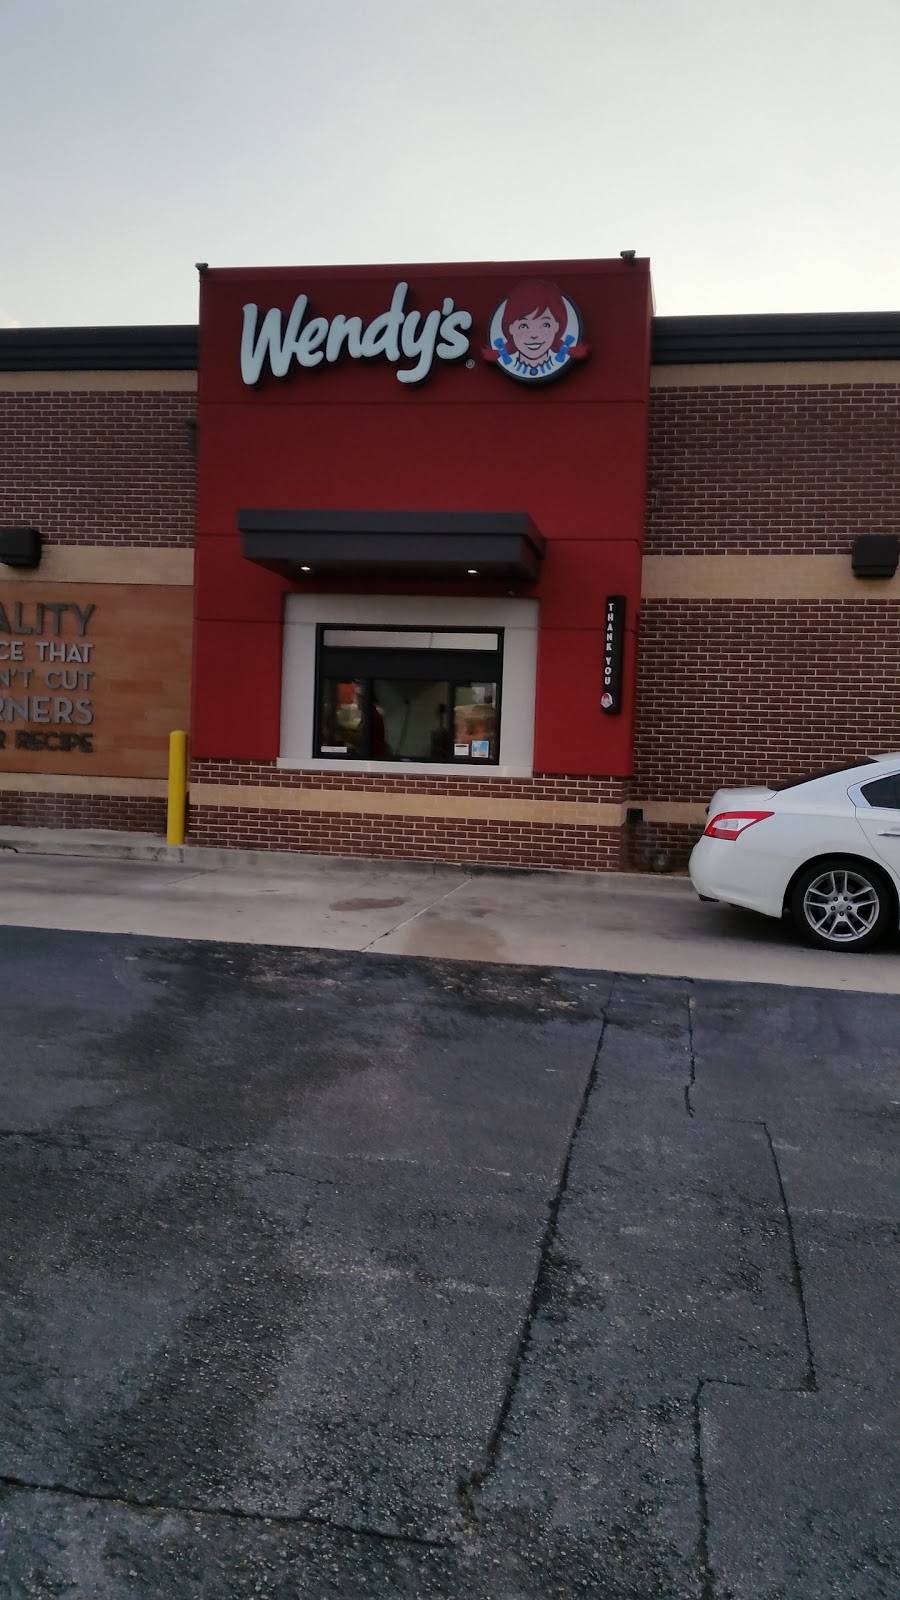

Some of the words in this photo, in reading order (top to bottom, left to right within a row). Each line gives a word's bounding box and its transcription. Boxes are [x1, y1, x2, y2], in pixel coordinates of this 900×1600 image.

[241, 282, 472, 385] Wendy's
[606, 603, 614, 651] THANK
[36, 640, 94, 663] THAT
[47, 671, 94, 690] CUT
[604, 657, 612, 685] YOU
[16, 730, 94, 753] RECIPE
